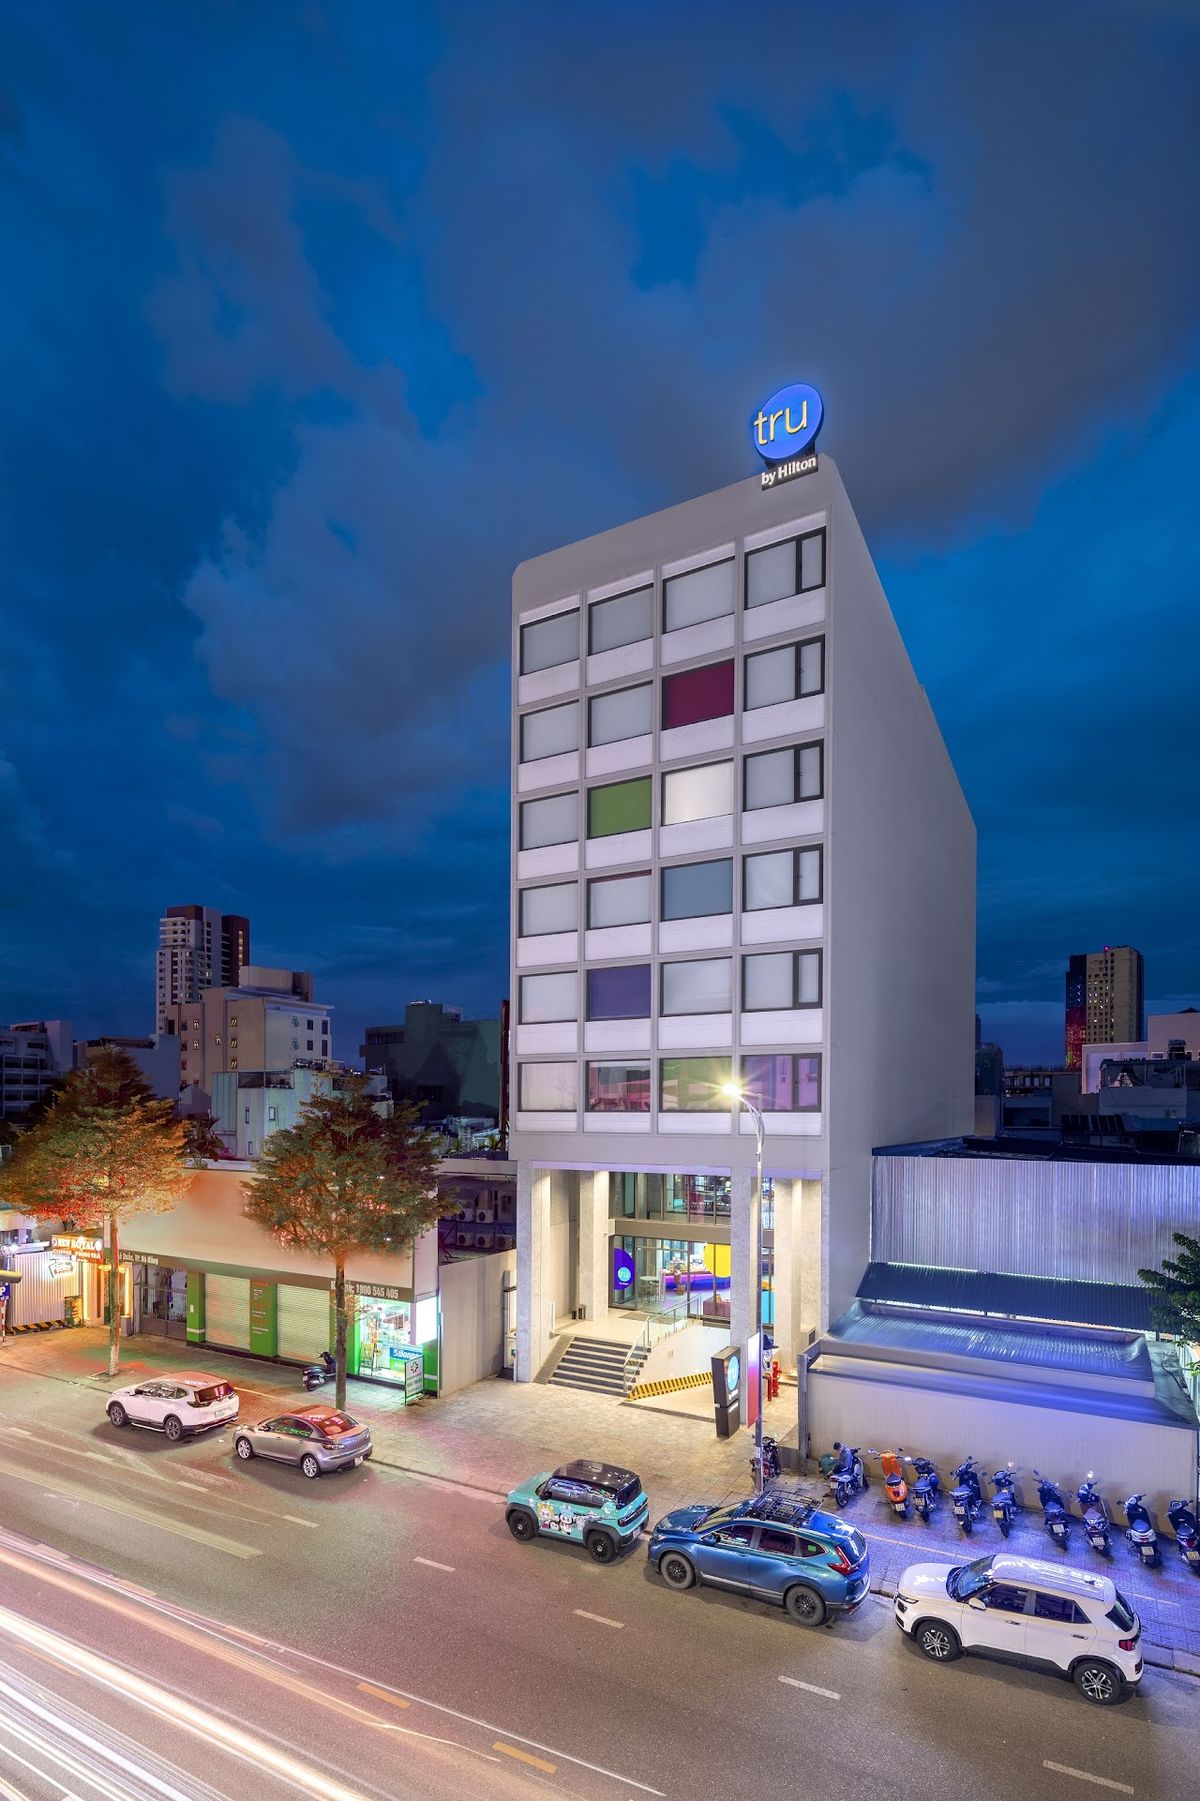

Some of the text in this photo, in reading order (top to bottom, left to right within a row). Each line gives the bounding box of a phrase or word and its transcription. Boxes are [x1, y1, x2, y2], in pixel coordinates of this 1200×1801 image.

[754, 400, 808, 445] tru
[761, 457, 817, 485] by Hilton
[356, 1283, 371, 1296] 1900
[372, 1286, 385, 1298] 545
[386, 1287, 399, 1299] 405
